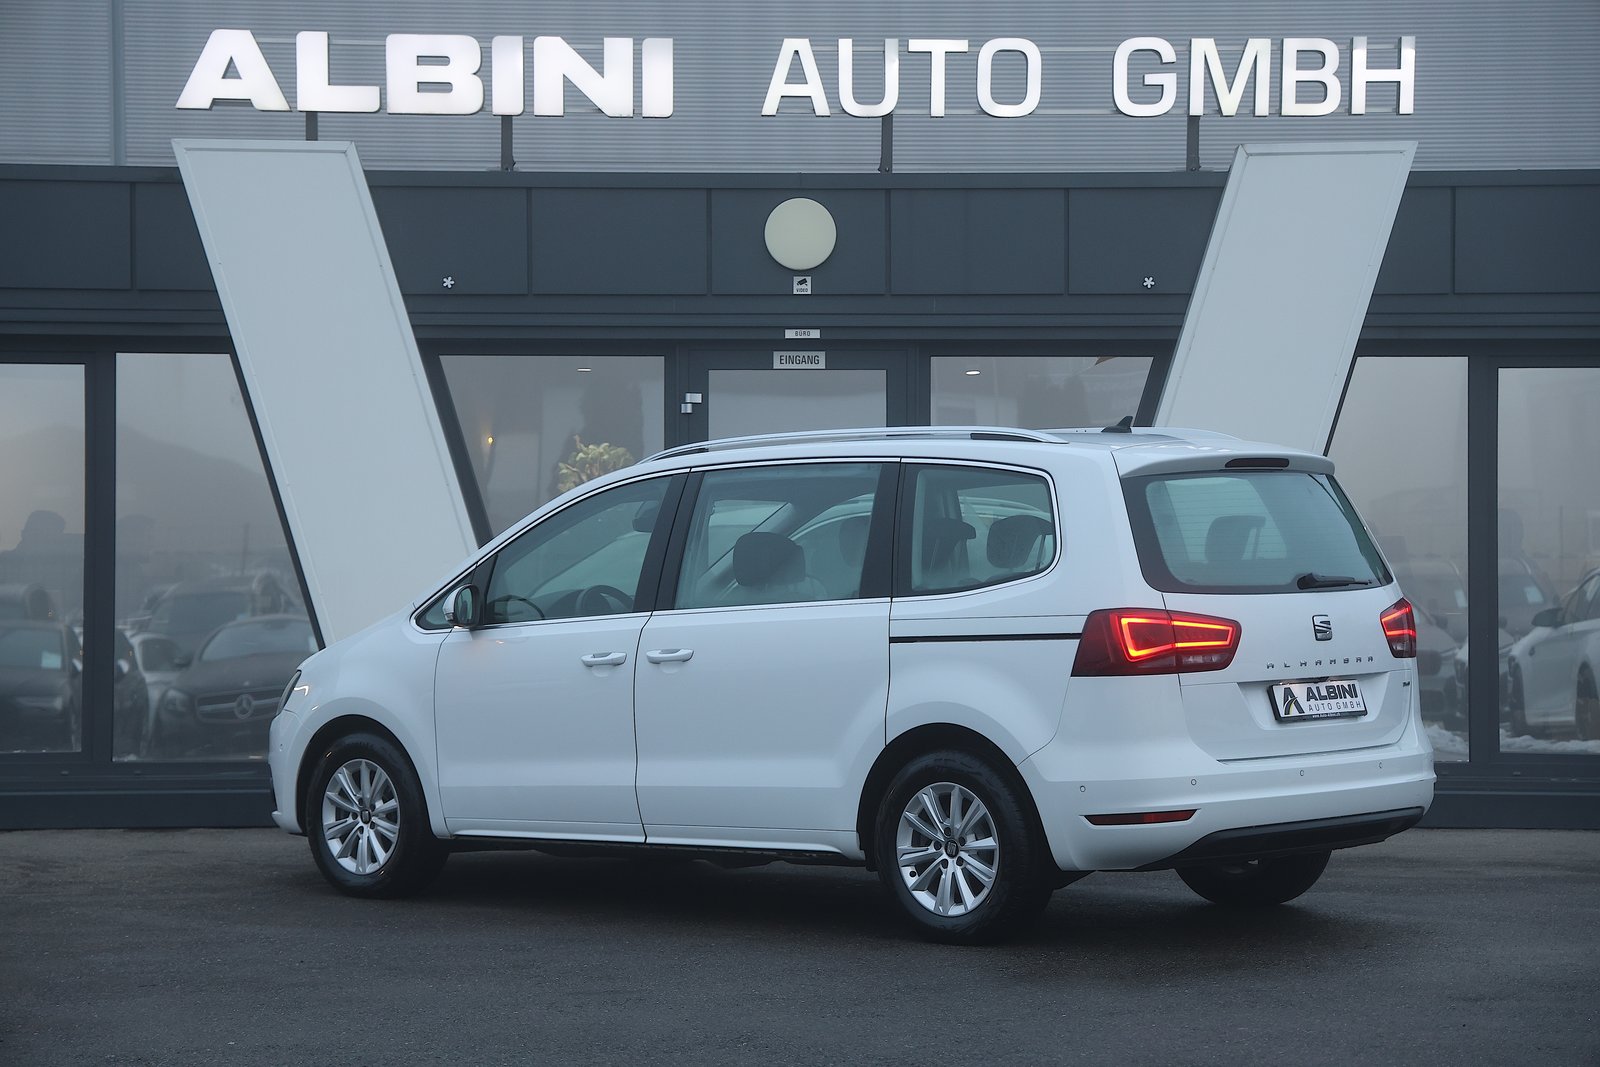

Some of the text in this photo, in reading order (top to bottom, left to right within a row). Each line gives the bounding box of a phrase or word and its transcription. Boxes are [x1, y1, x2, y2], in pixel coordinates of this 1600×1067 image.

[176, 28, 1416, 118] ALBINI AUTO GMBH
[779, 355, 820, 365] EINGANG
[1266, 656, 1374, 669] ALHAMBRA
[1306, 684, 1358, 702] ALBINI
[1308, 701, 1362, 712] AUTO GMBH
